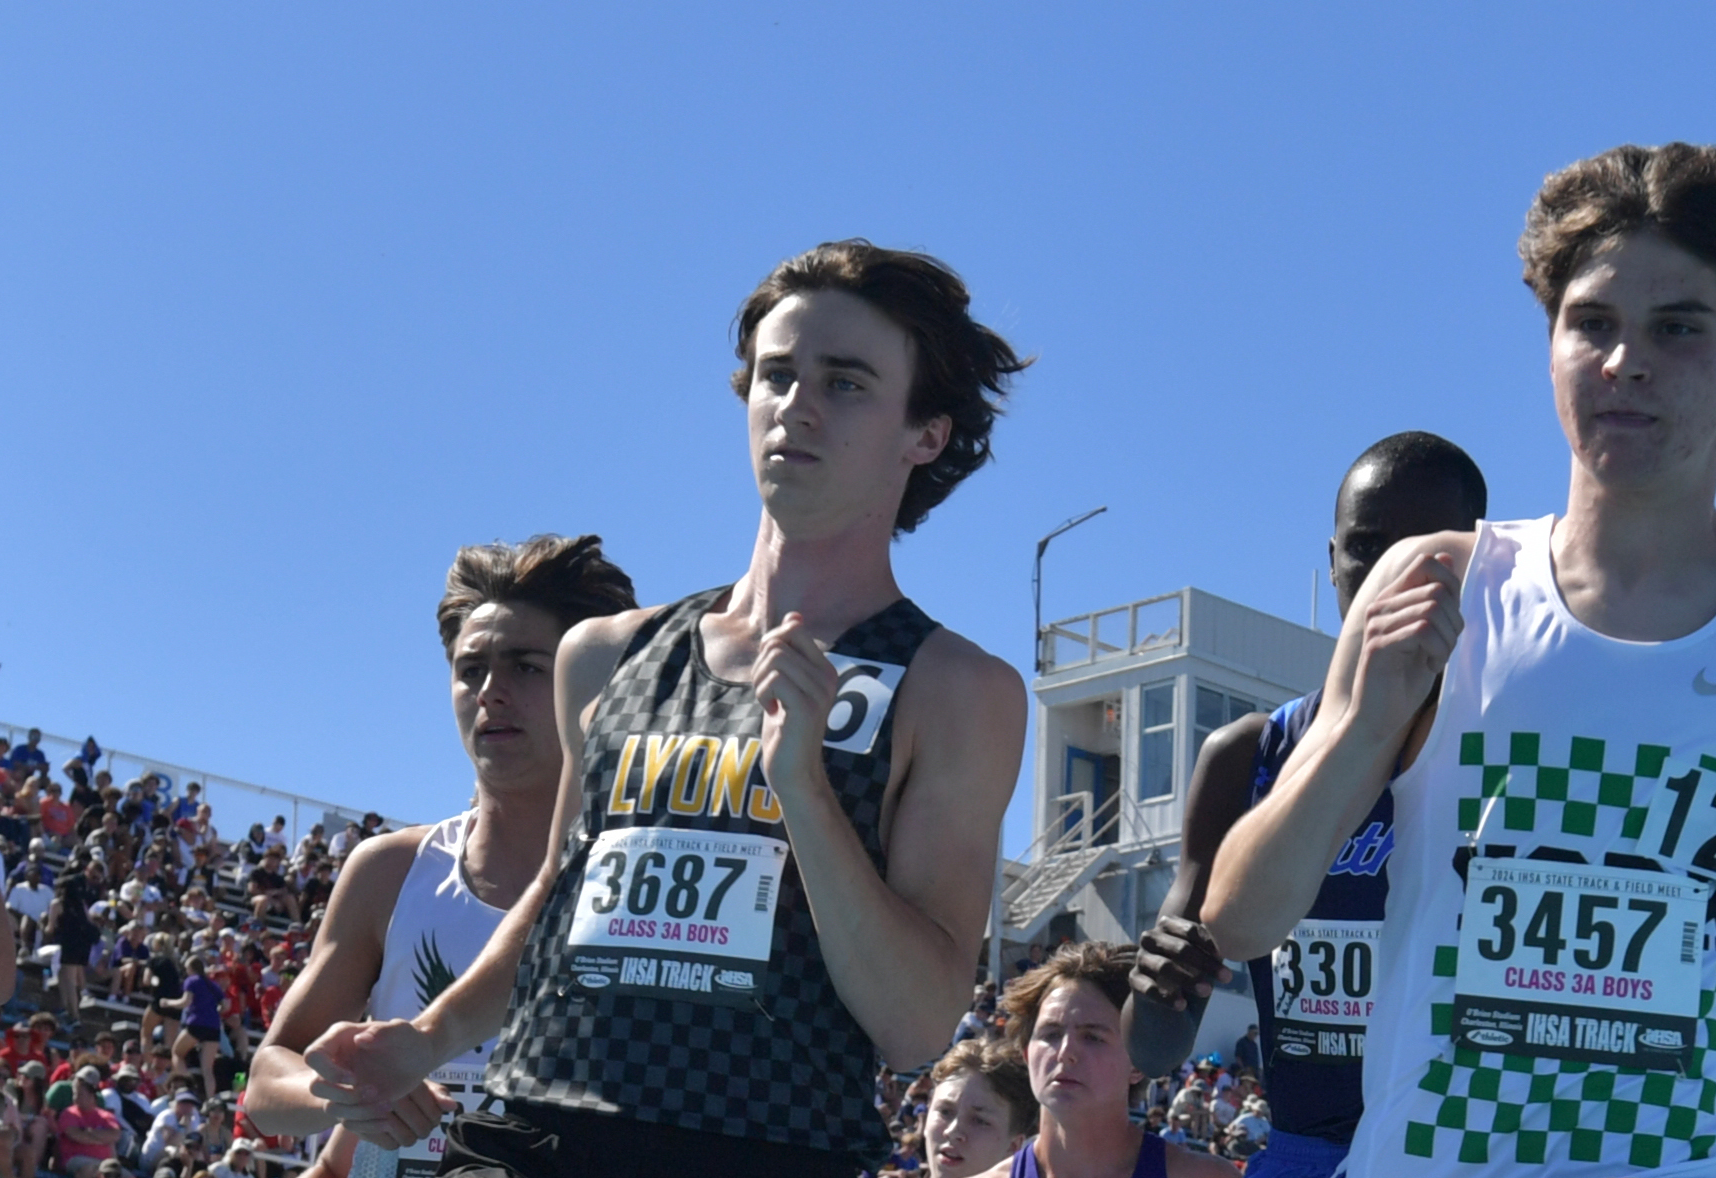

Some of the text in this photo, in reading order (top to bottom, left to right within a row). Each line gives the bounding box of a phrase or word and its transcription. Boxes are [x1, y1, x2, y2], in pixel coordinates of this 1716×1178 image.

[823, 663, 883, 742] 6
[650, 838, 674, 850] STATE
[676, 840, 702, 851] TRACK
[713, 843, 737, 854] FIELD
[741, 845, 763, 855] MEET
[591, 851, 748, 921] 3687
[1491, 869, 1683, 898] 2024 IHSA STATE TRACK & FIELD MEET
[608, 918, 730, 946] CLASS 3A BOYS
[1317, 928, 1339, 939] STATE
[1340, 929, 1365, 939] TRACK
[1477, 885, 1669, 974] 3457
[619, 956, 716, 994] IHSA TRACK
[1280, 939, 1372, 999] 330
[1504, 966, 1654, 1001] CLASS 3A BOYS
[1300, 998, 1340, 1016] CLASS
[1343, 1001, 1362, 1017] 3A
[1317, 1030, 1348, 1057] IHSA
[1525, 1012, 1638, 1055] IHSA TRACK
[449, 1070, 470, 1081] STATE
